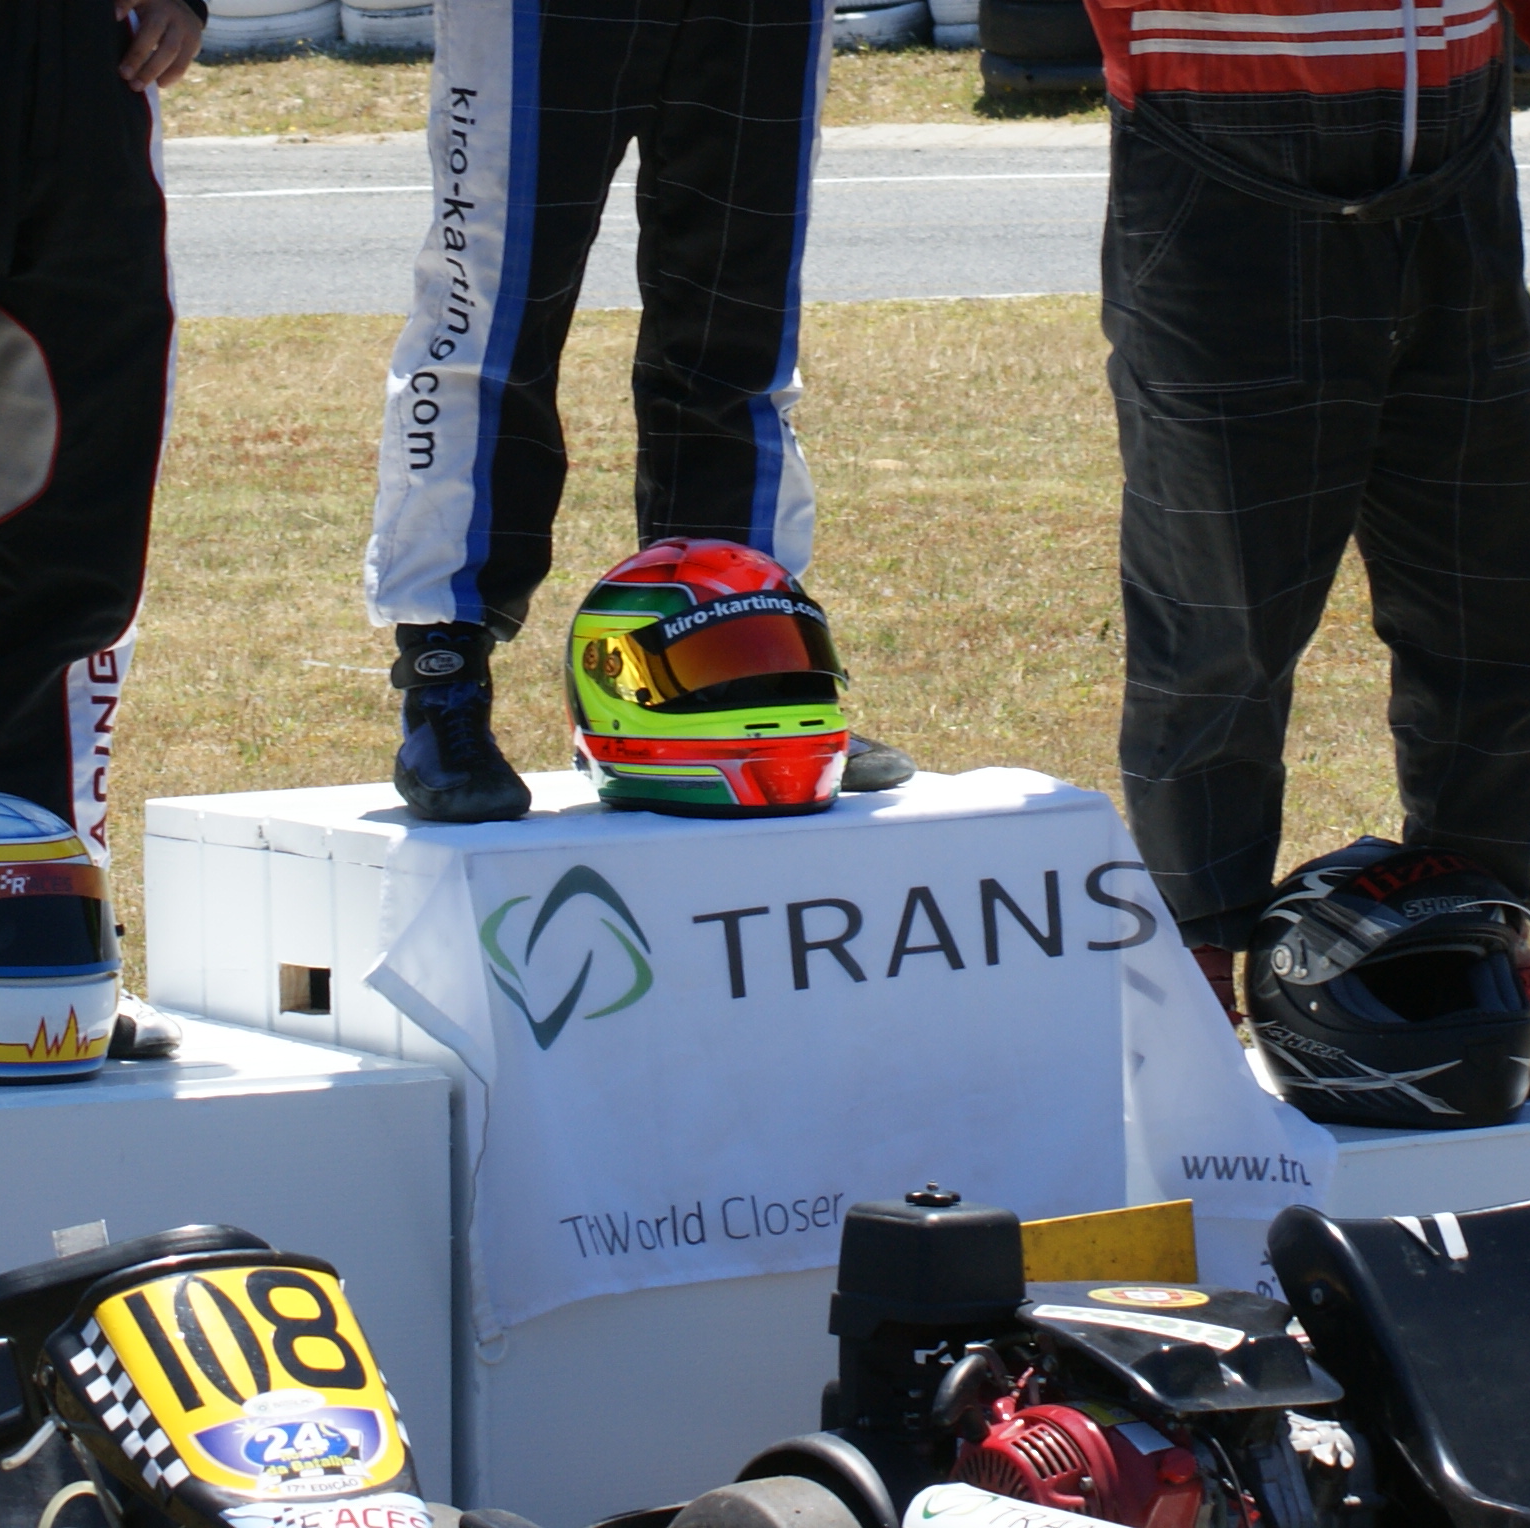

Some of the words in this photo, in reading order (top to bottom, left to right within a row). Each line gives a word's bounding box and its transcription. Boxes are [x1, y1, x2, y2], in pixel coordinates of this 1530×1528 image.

[407, 86, 478, 471] kiro-kartingcom
[87, 649, 120, 854] ACING
[692, 859, 1159, 999] TRANS
[721, 1192, 844, 1241] Closer
[122, 1268, 368, 1413] 108
[255, 1423, 330, 1462] 24
